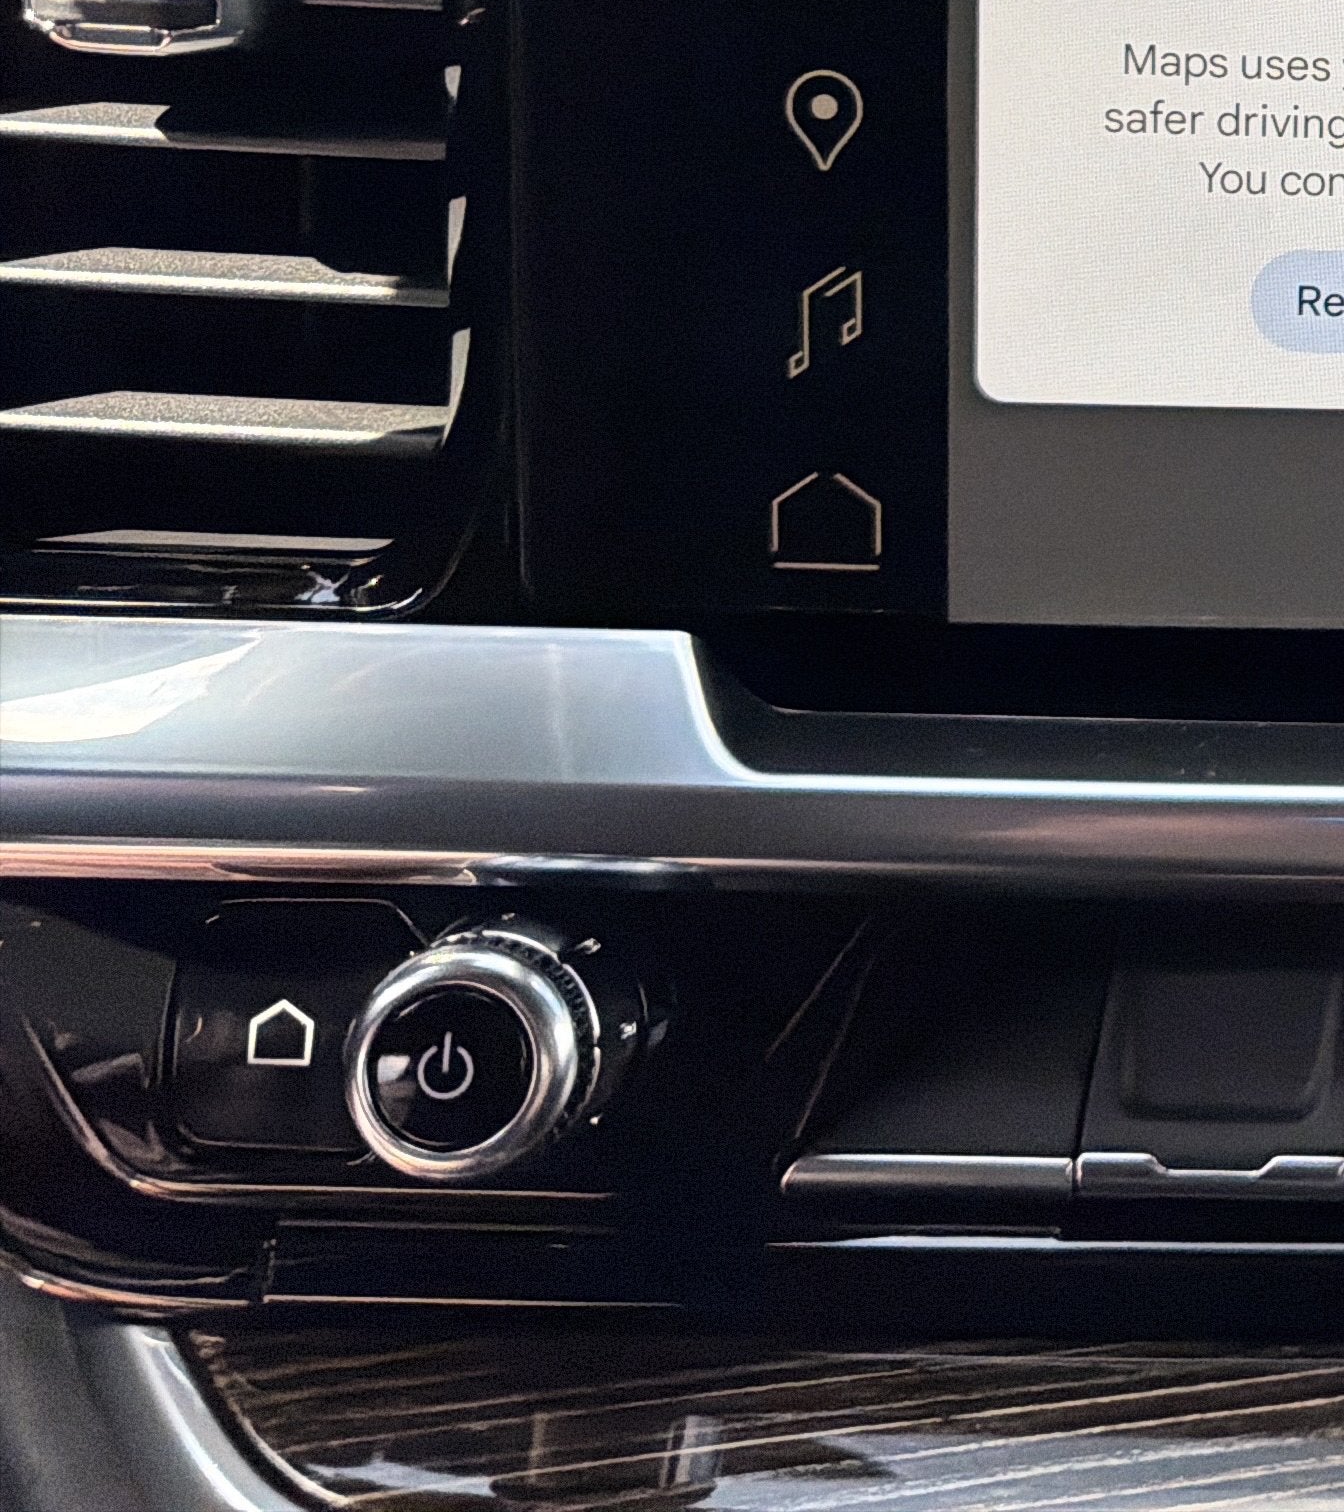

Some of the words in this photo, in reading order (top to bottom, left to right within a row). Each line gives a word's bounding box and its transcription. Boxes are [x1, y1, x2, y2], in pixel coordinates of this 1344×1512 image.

[1123, 42, 1229, 86] Maps
[1240, 54, 1331, 83] uses
[1104, 98, 1204, 136] safer
[1199, 161, 1267, 196] You
